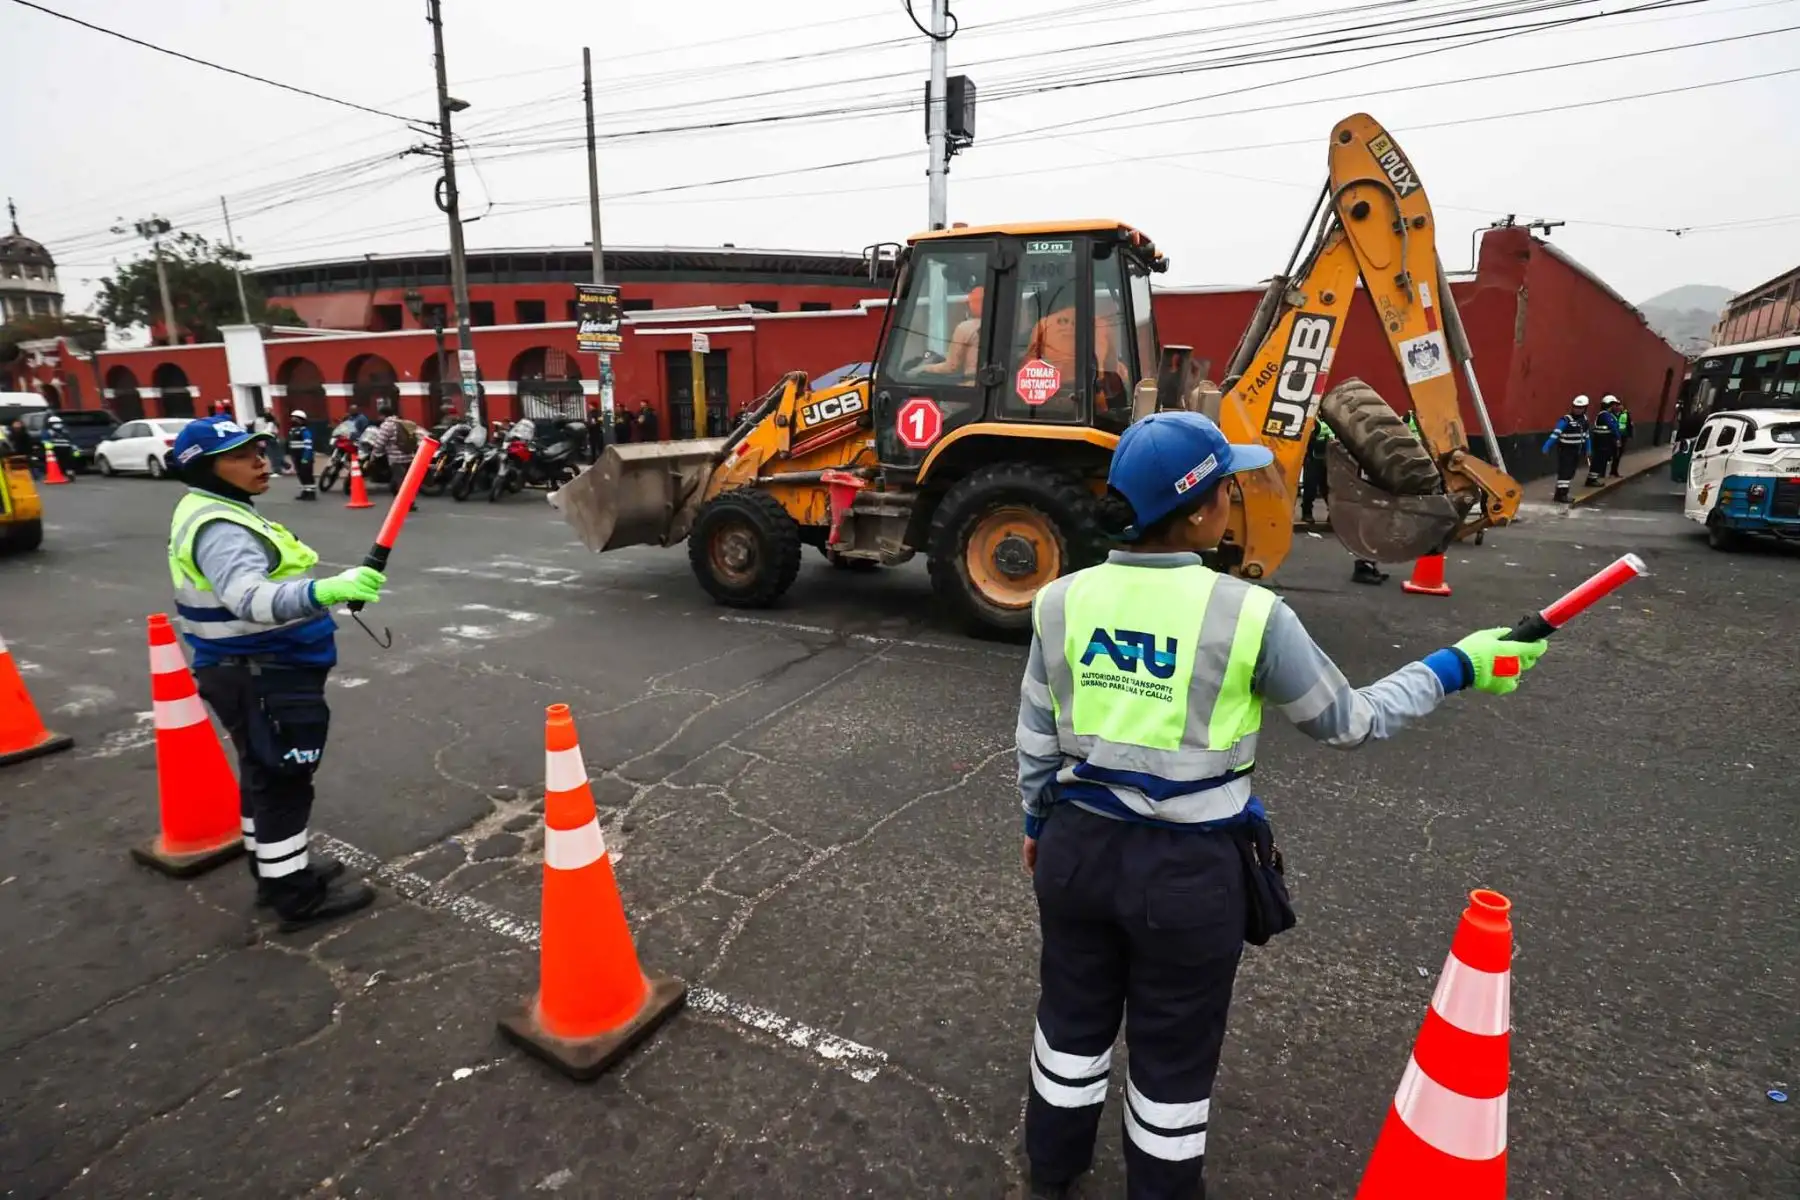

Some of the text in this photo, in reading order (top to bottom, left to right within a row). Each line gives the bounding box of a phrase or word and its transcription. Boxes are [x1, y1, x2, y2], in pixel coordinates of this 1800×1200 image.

[1020, 379, 1056, 389] DISTANCIA
[1026, 368, 1054, 378] TOMAR
[1247, 361, 1280, 396] 7406
[1271, 318, 1331, 436] JCB
[805, 391, 863, 425] JCB
[909, 408, 924, 439] 1
[1080, 627, 1178, 679] ATU
[1081, 672, 1120, 681] AUTORIDAD
[1081, 680, 1107, 688] URBANO
